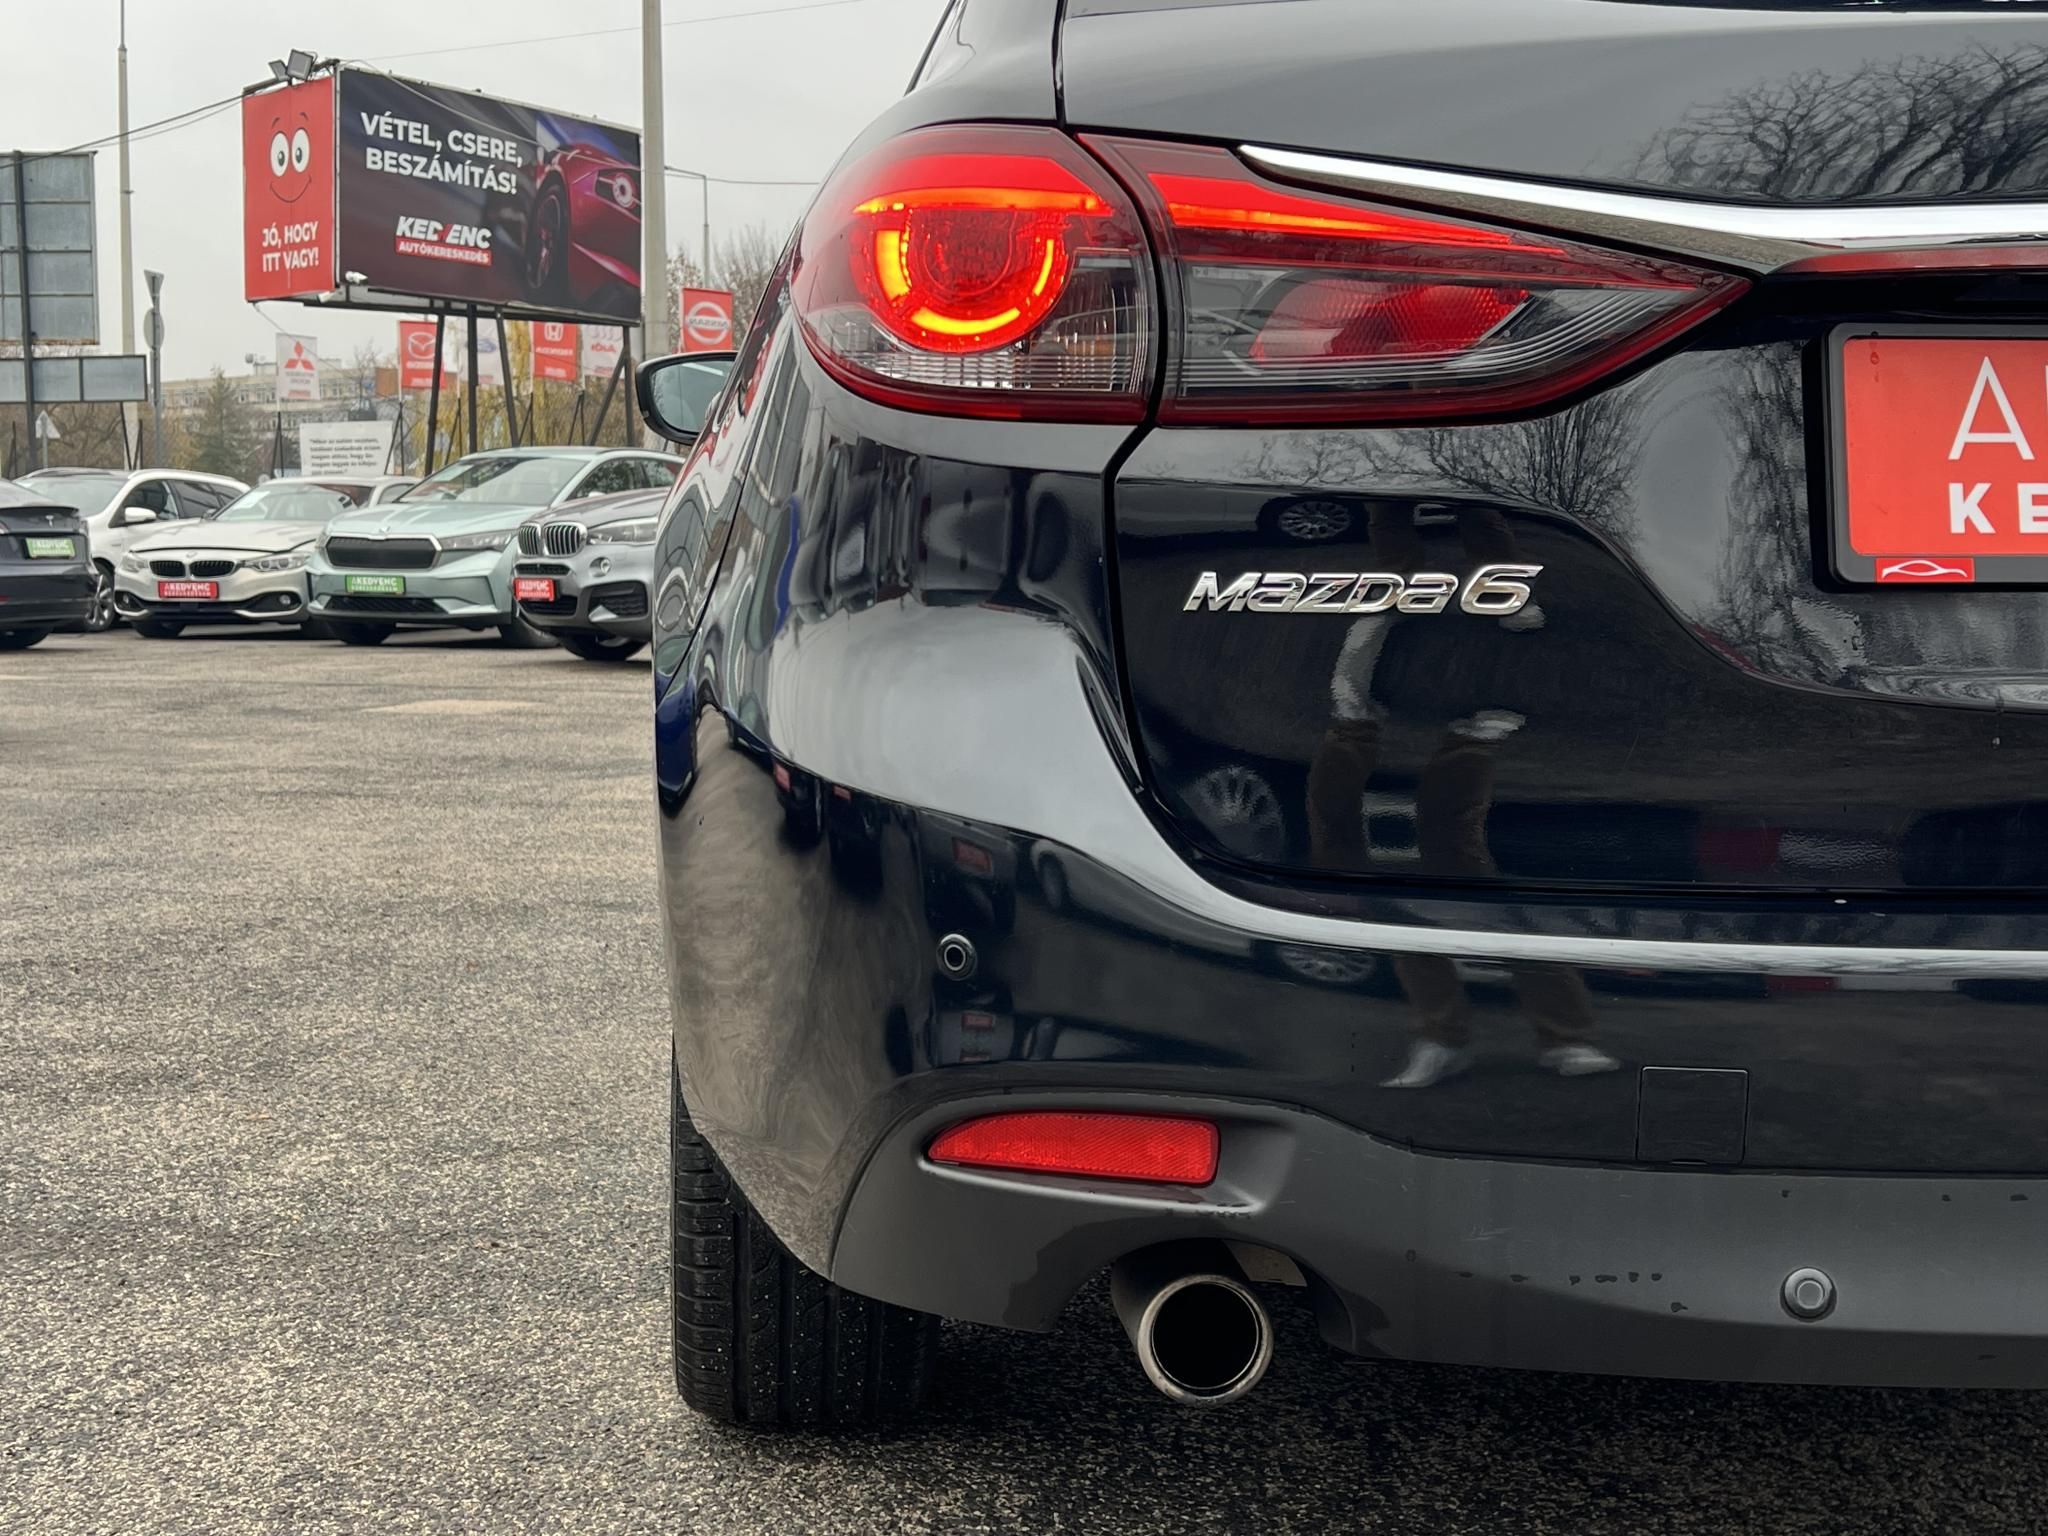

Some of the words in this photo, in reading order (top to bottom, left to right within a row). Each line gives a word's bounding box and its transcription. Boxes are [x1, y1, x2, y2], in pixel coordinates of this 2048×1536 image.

[361, 111, 443, 152] VÉTEL,
[447, 130, 523, 168] CSERE,
[366, 147, 517, 194] BESZÁMÍTÁS!
[262, 222, 282, 248] JÓ,
[284, 221, 319, 245] HOGY
[399, 241, 489, 263] AUTÓKERESKEDÉS
[262, 252, 281, 272] ITT
[283, 247, 319, 269] VAGY!
[1947, 482, 2048, 534] KE
[1183, 564, 1544, 616] Mazda6
